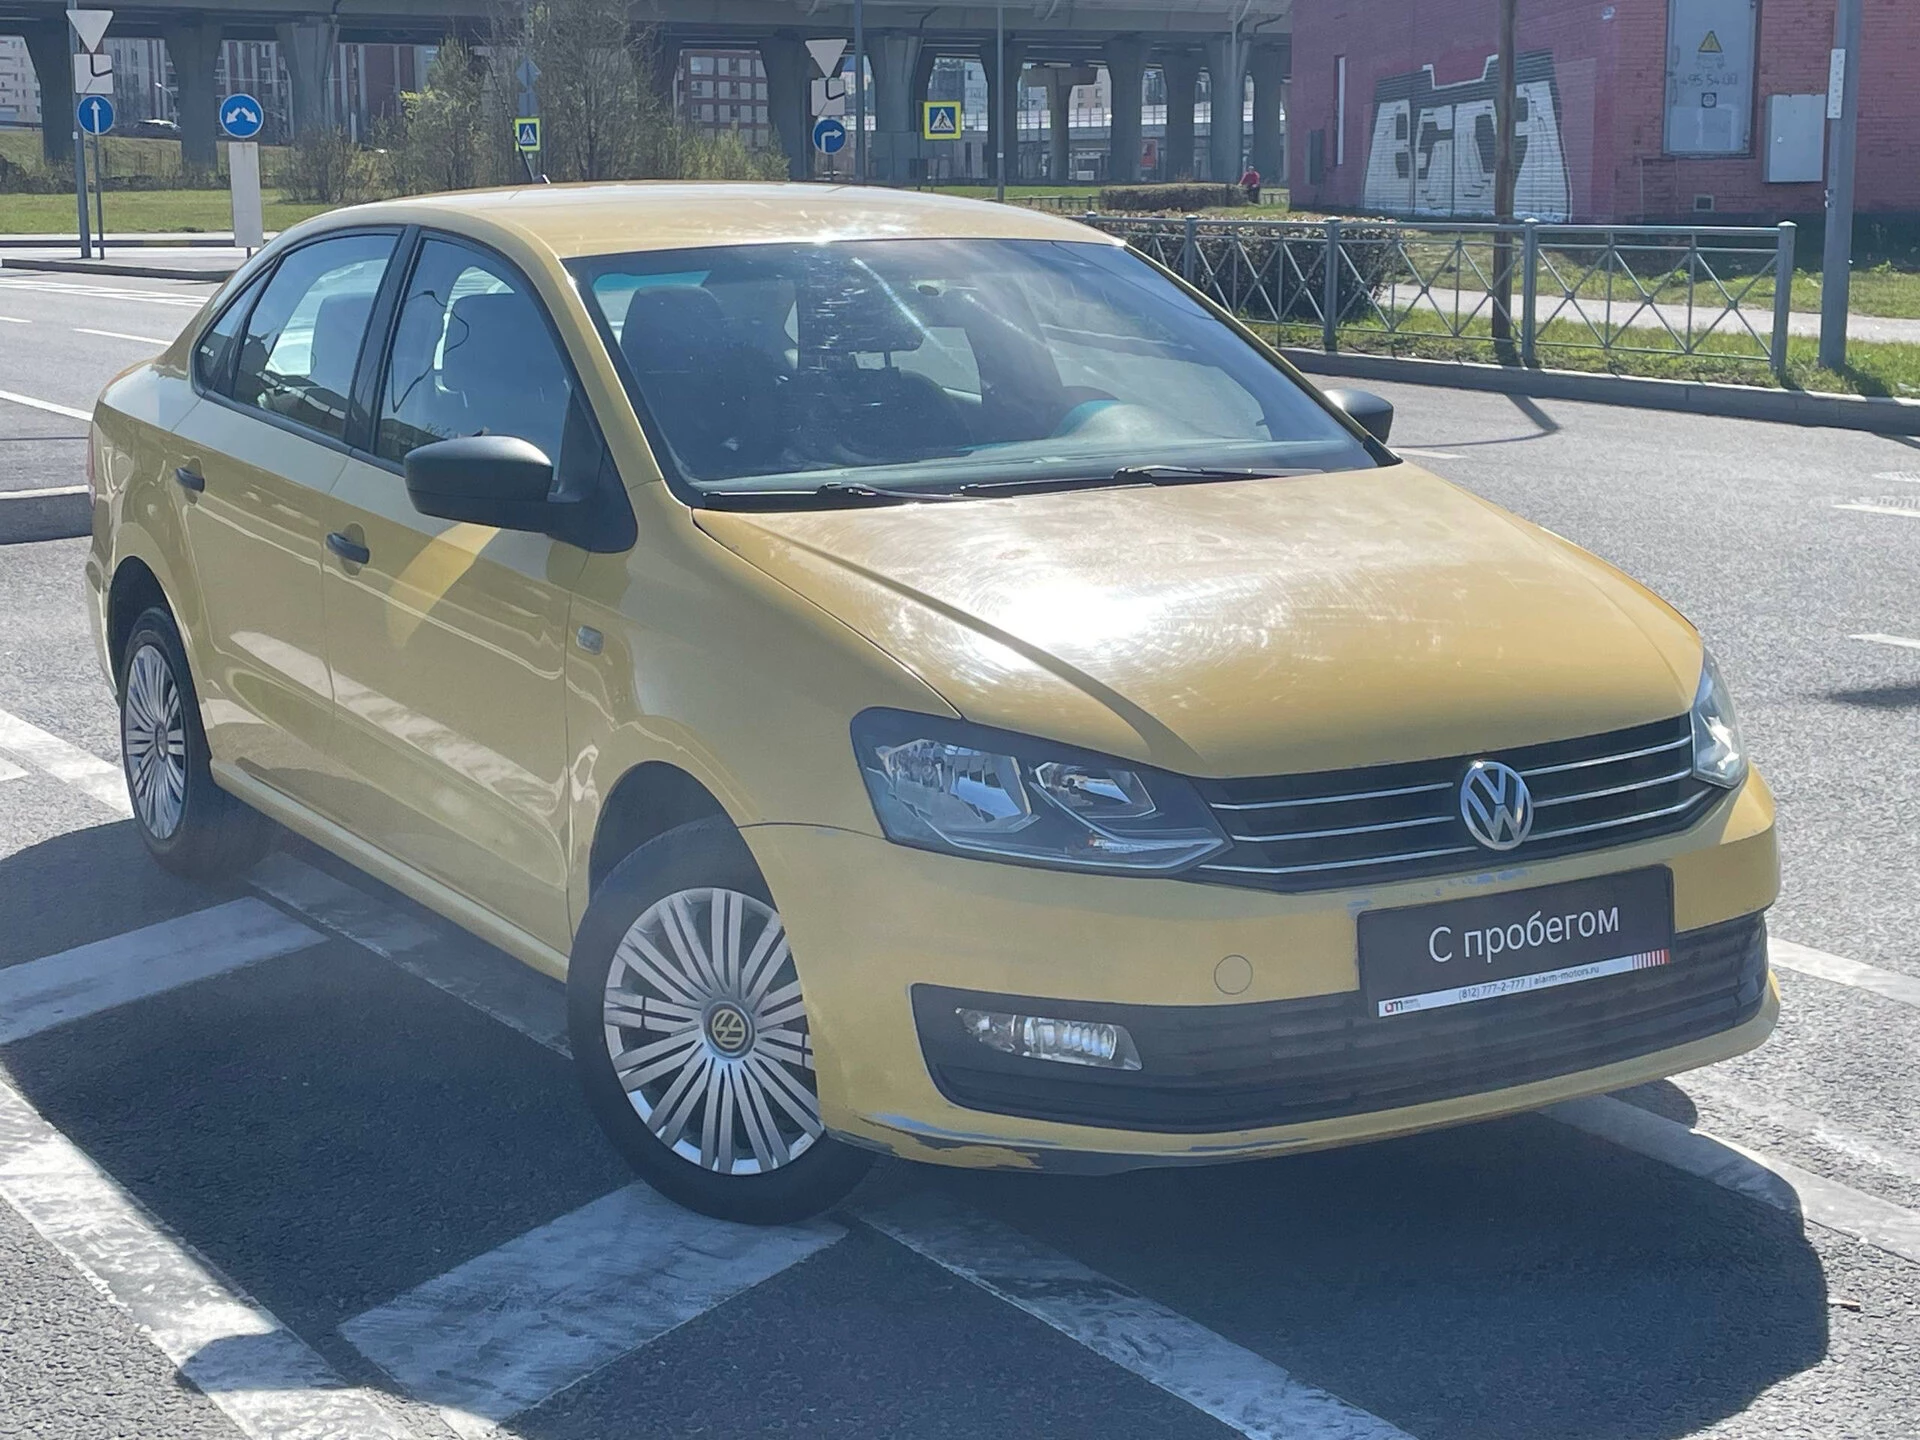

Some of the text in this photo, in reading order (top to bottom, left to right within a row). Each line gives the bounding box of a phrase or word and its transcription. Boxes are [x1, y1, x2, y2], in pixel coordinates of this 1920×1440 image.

[1429, 907, 1619, 963] С пробегом
[1459, 987, 1480, 1001] (812)
[1482, 979, 1526, 996] 777-2-777
